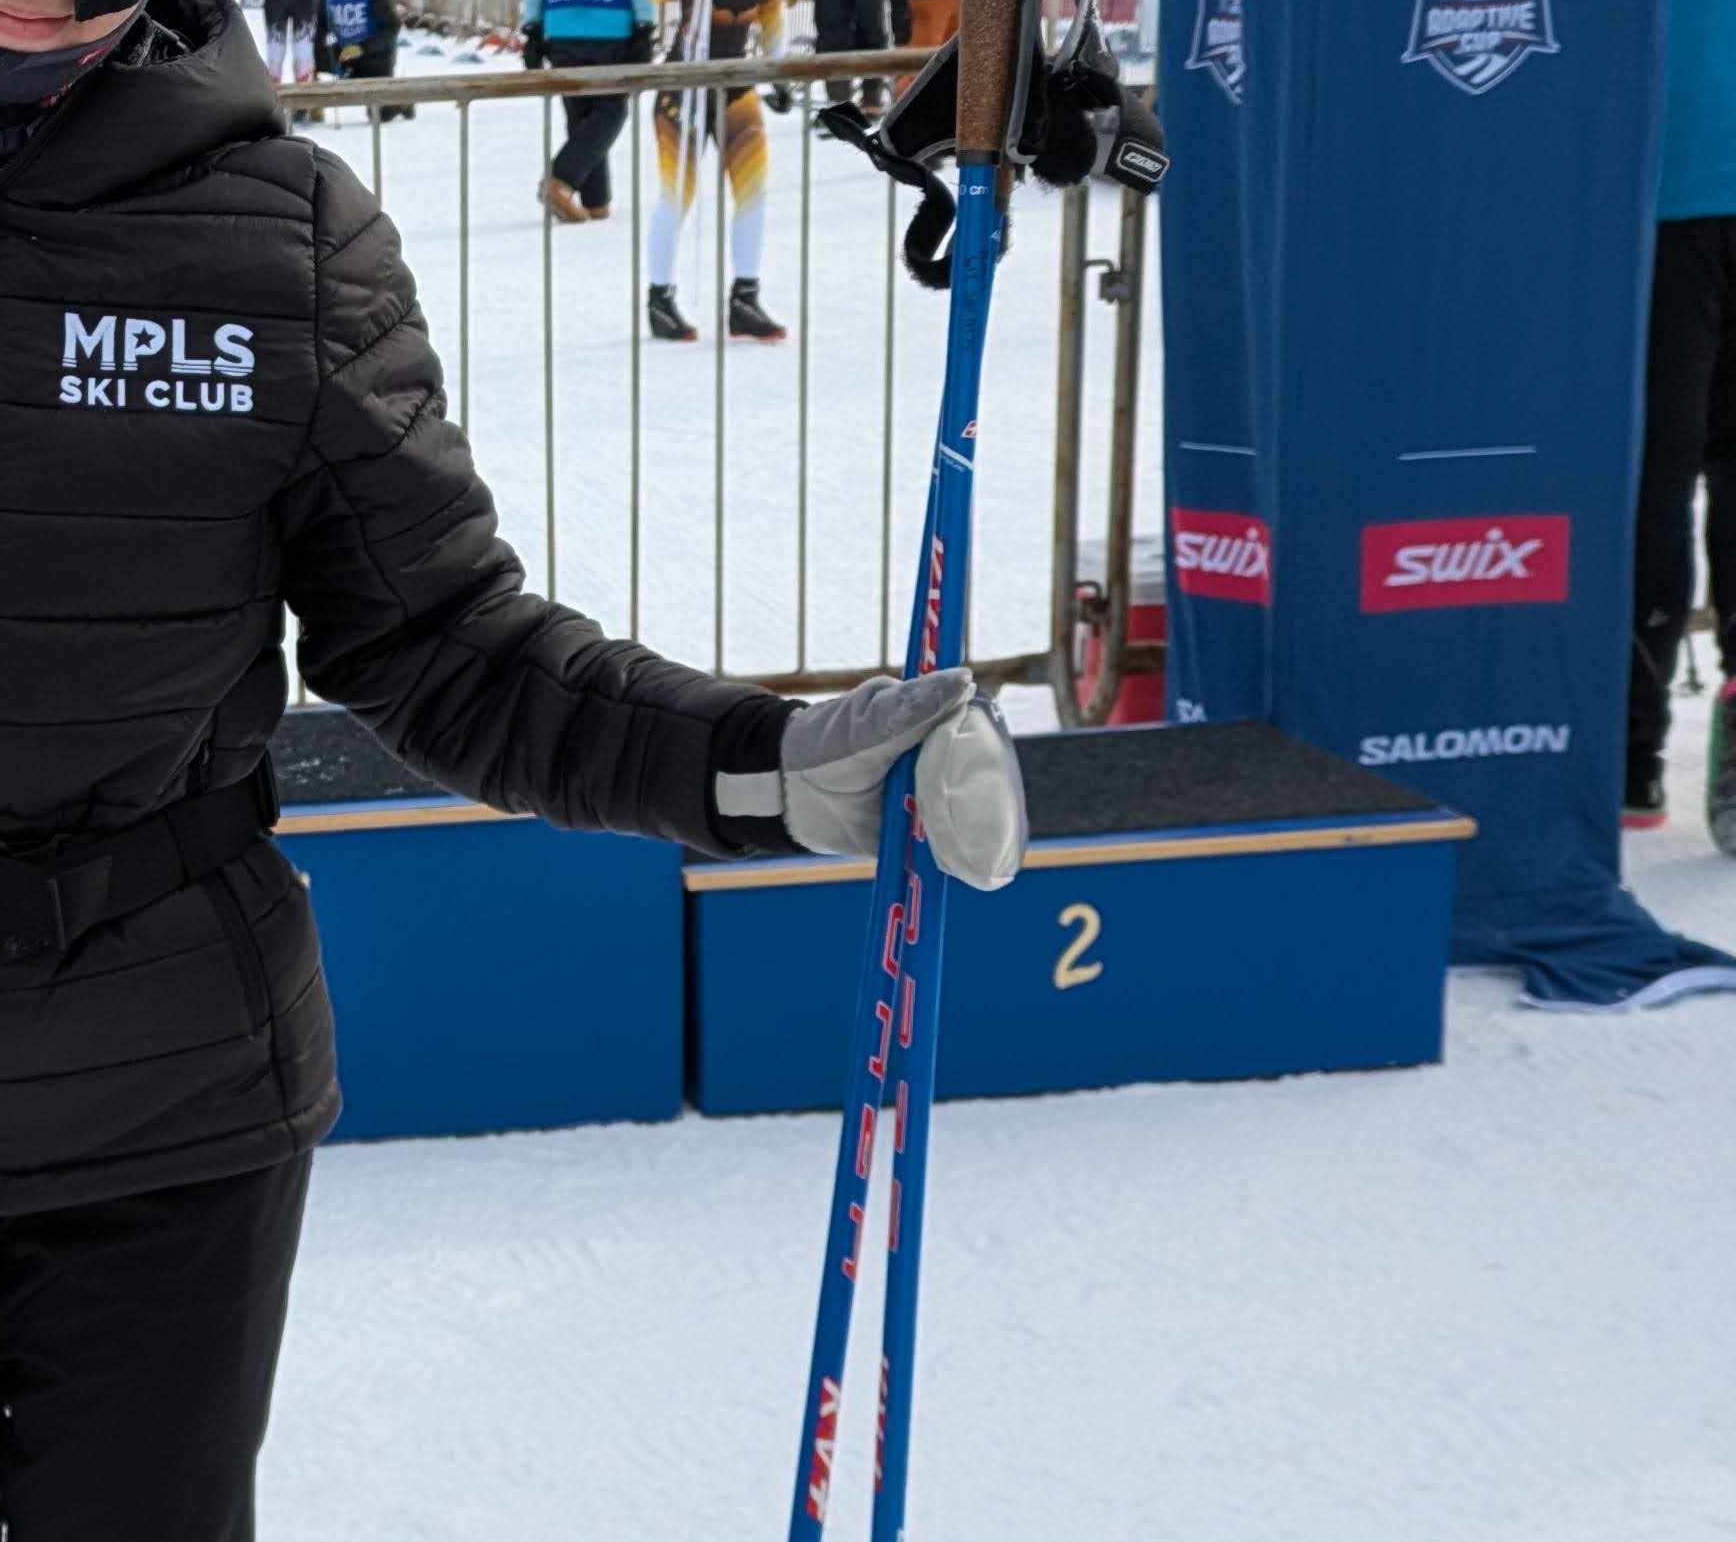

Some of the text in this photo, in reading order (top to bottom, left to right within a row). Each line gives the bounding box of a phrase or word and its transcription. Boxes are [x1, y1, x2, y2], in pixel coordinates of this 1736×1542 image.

[62, 312, 255, 377] MPLS
[59, 376, 254, 412] SKI CLUB
[1359, 726, 1568, 765] SALOMON
[1053, 904, 1102, 989] 2
